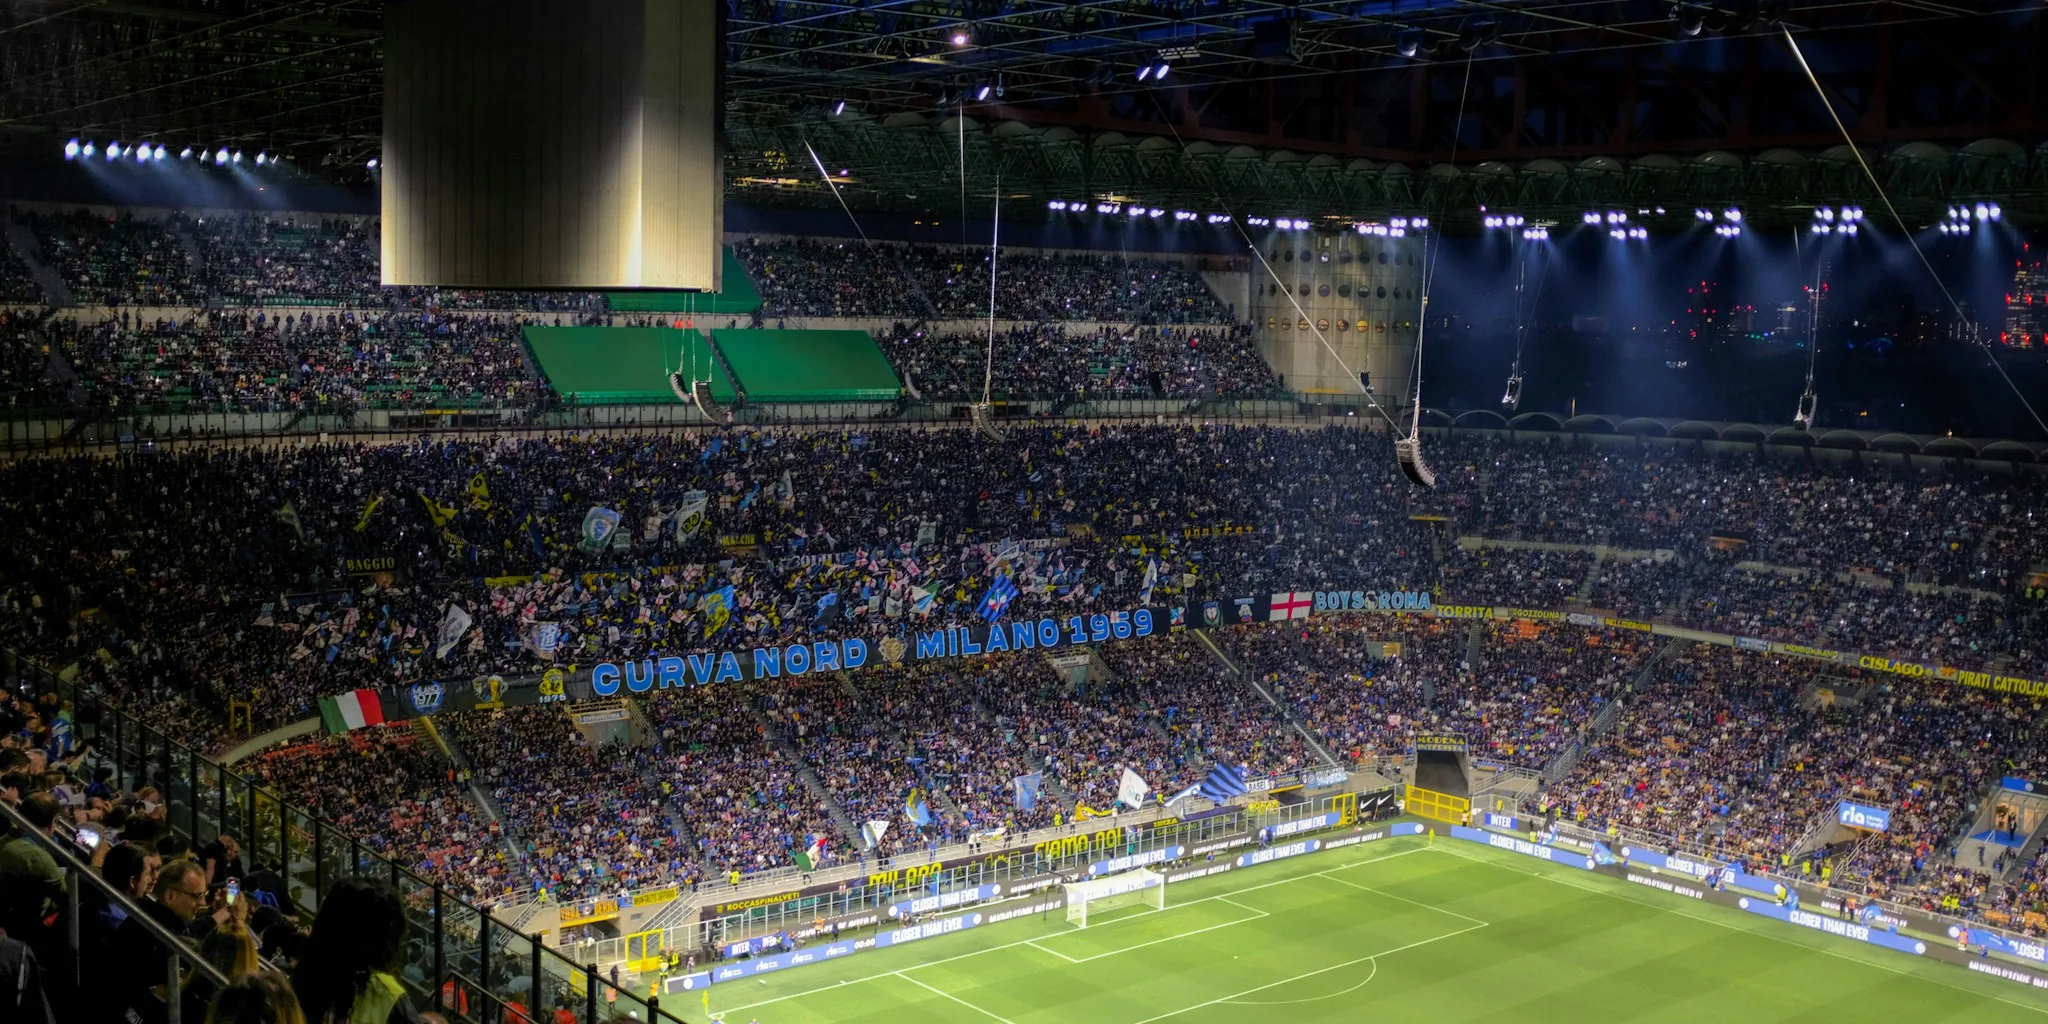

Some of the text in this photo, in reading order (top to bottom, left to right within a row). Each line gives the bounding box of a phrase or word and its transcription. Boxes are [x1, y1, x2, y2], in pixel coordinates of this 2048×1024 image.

[347, 557, 395, 571] BAGGIO
[1315, 591, 1431, 610] BOYS ROMA
[1436, 605, 1493, 619] TORRITA
[1517, 609, 1560, 619] GOZZOLINA
[916, 609, 1153, 659] MILANO 1969
[592, 638, 867, 696] CURVA NORD
[1859, 656, 1924, 677] CISLAGO
[1958, 670, 2048, 698] PIRATI CATTOLICA
[414, 691, 440, 705] 1977
[1417, 736, 1465, 745] MODENA
[1490, 813, 1512, 828] INTER
[1842, 806, 1865, 825] ria
[1490, 834, 1514, 849] CLOSER
[1534, 844, 1552, 859] EVER
[1666, 856, 1694, 873] CLOSER
[1695, 863, 1712, 879] THA
[727, 892, 800, 911] ROCCASPINALVETI
[911, 887, 979, 913] CLOSER THAN EVER
[892, 926, 922, 944] CLOSER
[923, 920, 942, 937] THAN
[943, 916, 962, 933] EVER
[1790, 911, 1821, 929] CLOSER
[1823, 918, 1846, 935] THAN
[1847, 924, 1869, 941] EVER
[732, 941, 750, 955] INTER
[854, 938, 876, 950] 00:00
